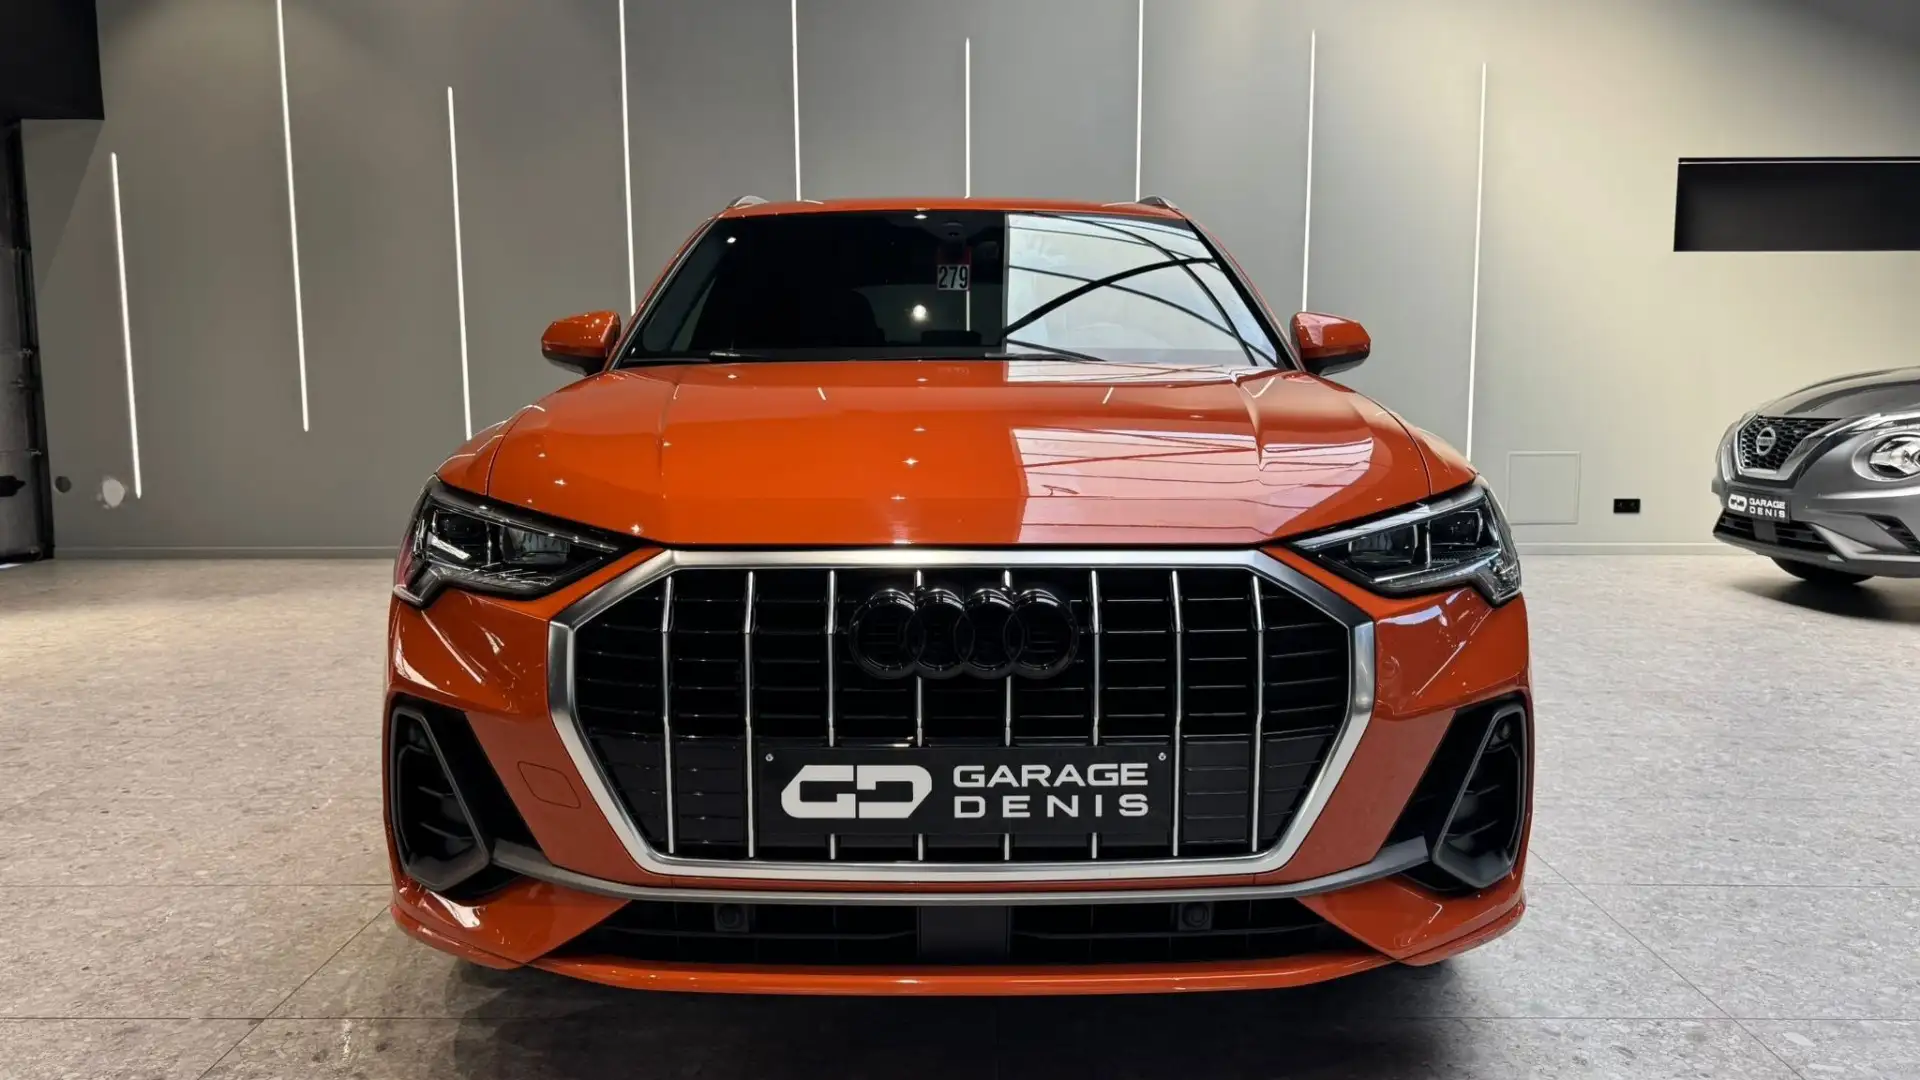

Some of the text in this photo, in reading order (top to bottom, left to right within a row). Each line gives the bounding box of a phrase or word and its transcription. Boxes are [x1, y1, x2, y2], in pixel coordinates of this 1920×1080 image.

[938, 265, 969, 289] 279
[1749, 497, 1786, 509] GARAGE
[1749, 506, 1786, 518] DENIS
[953, 762, 1149, 788] GARAGE
[953, 793, 1149, 819] DENIS
